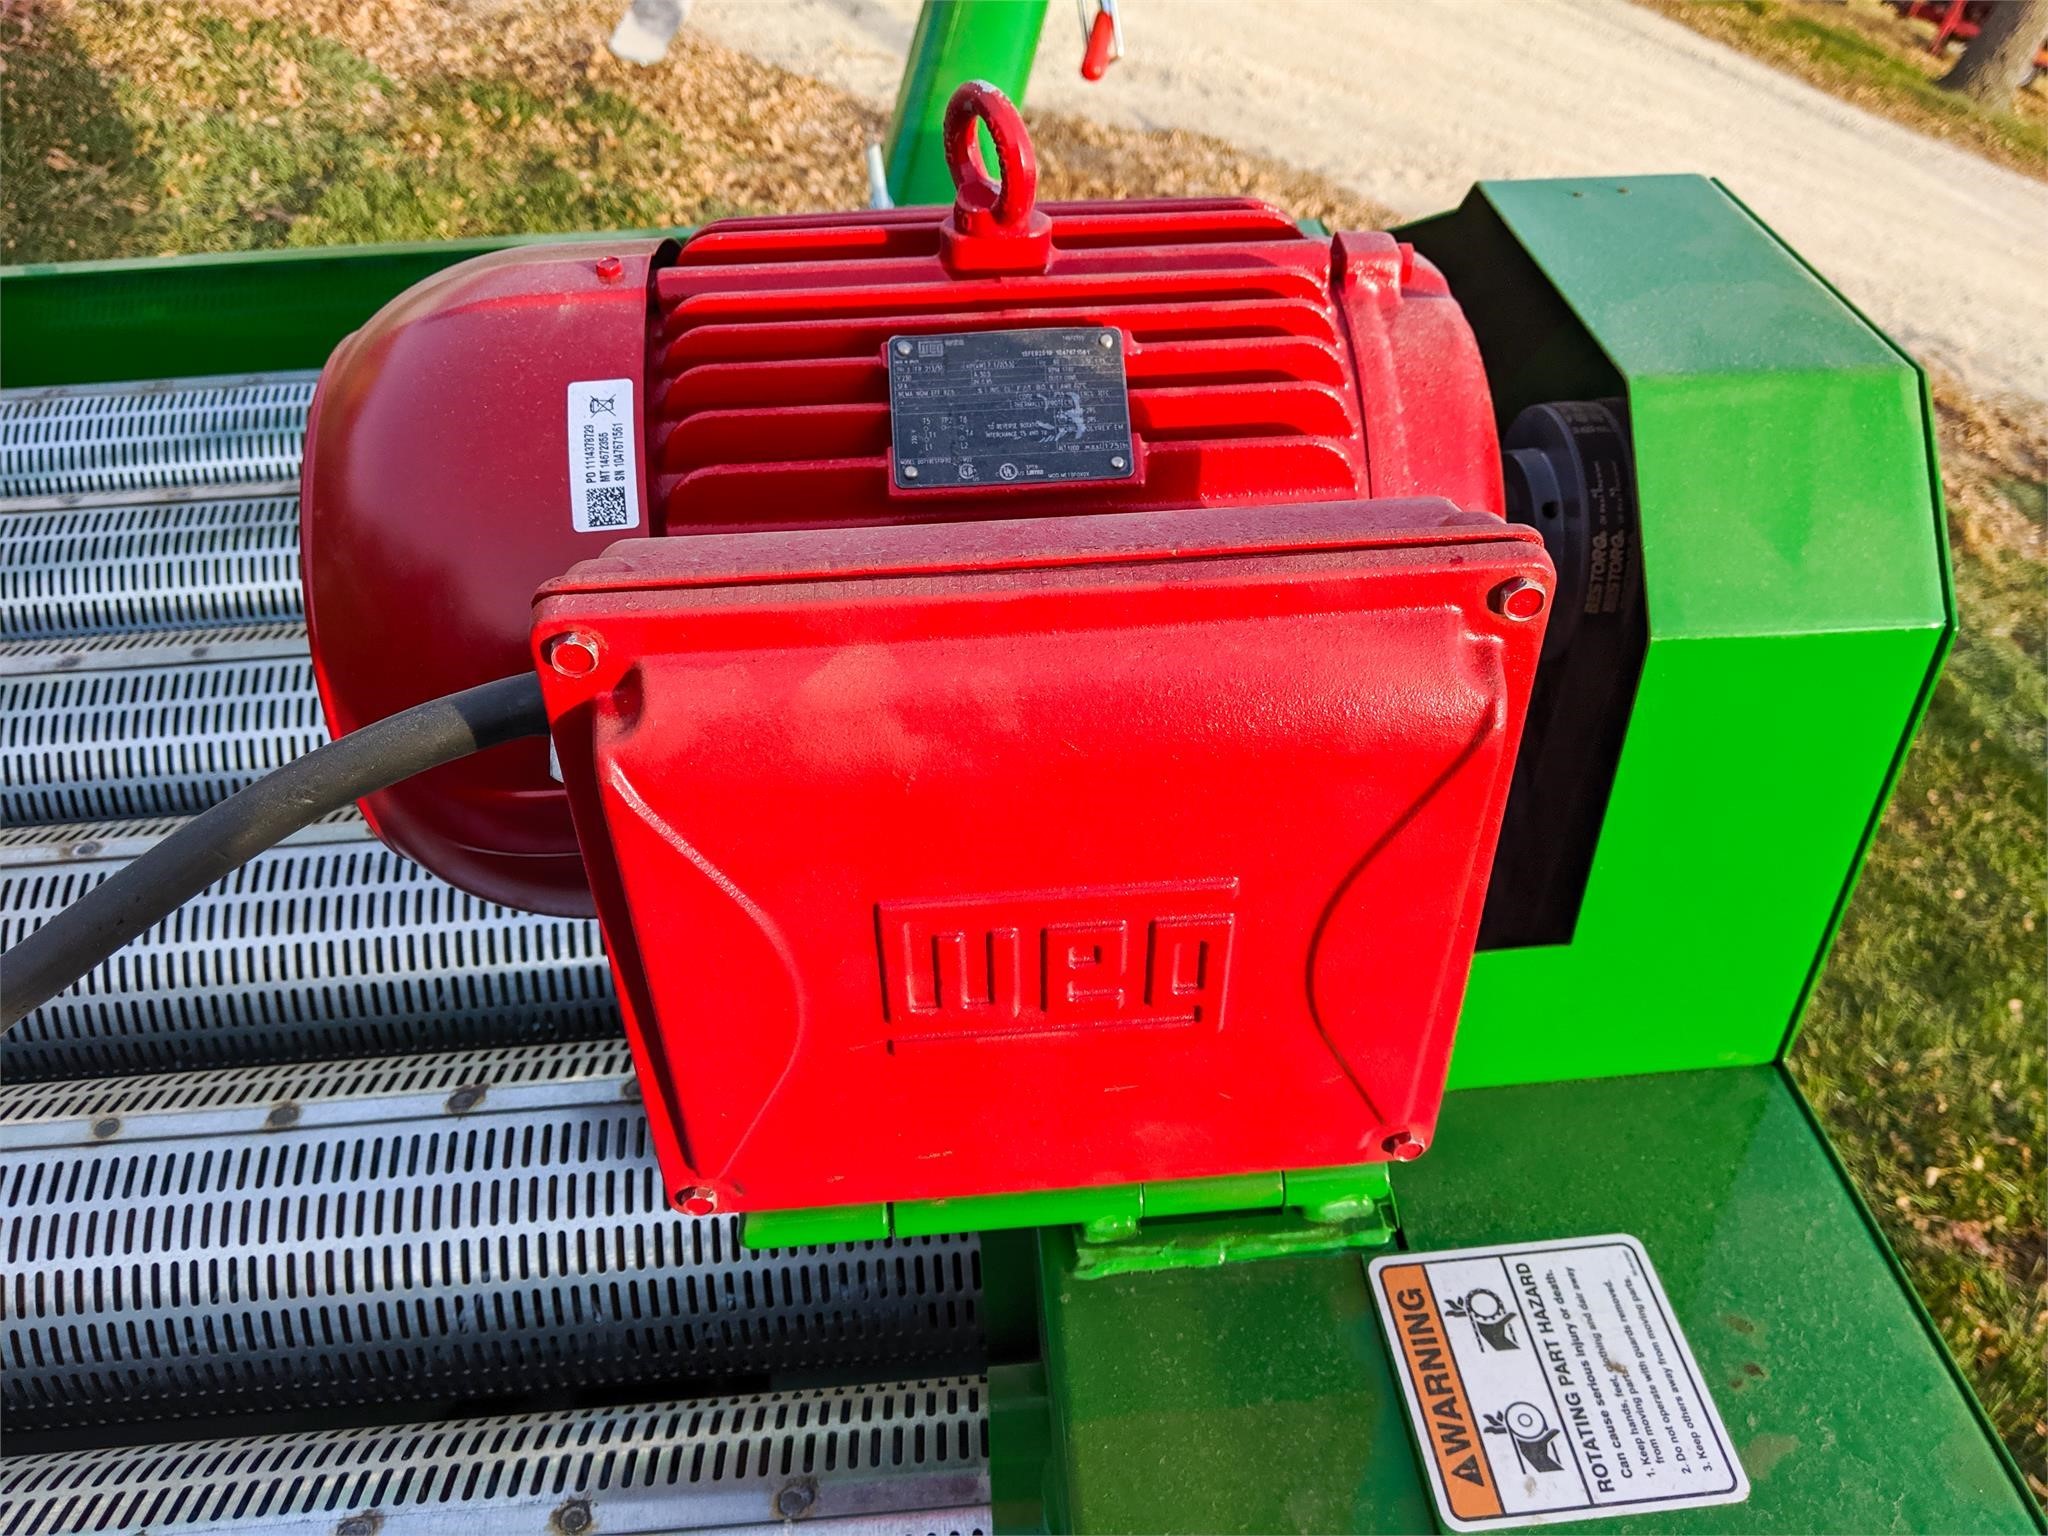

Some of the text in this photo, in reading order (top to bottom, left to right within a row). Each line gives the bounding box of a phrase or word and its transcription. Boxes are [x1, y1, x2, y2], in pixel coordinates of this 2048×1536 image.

[584, 424, 596, 483] PO 1114378729
[599, 432, 610, 482] MT 14672355
[612, 423, 625, 481] SN 1047671561
[1565, 1267, 1580, 1290] away
[1623, 1276, 1642, 1302] parts.
[1583, 1313, 1597, 1330] and
[1635, 1303, 1657, 1339] moving
[1592, 1333, 1613, 1372] clothing
[1649, 1341, 1667, 1365] from
[1396, 1287, 1472, 1456] WARNING
[1515, 1262, 1614, 1492] ROTATING PART HAZARD
[1545, 1269, 1633, 1478] Can cause serious injury or death.
[1603, 1279, 1692, 1474] 2. Do not operate with guards removed.
[1609, 1375, 1623, 1397] feet,
[1663, 1368, 1679, 1393] away
[1621, 1399, 1639, 1434] hands,
[1633, 1397, 1657, 1435] moving
[1675, 1396, 1694, 1429] others
[1635, 1437, 1652, 1465] Keep
[1651, 1438, 1666, 1464] from
[1692, 1431, 1708, 1459] Keep
[1647, 1468, 1656, 1478] 1.
[1703, 1461, 1712, 1472] 3.
